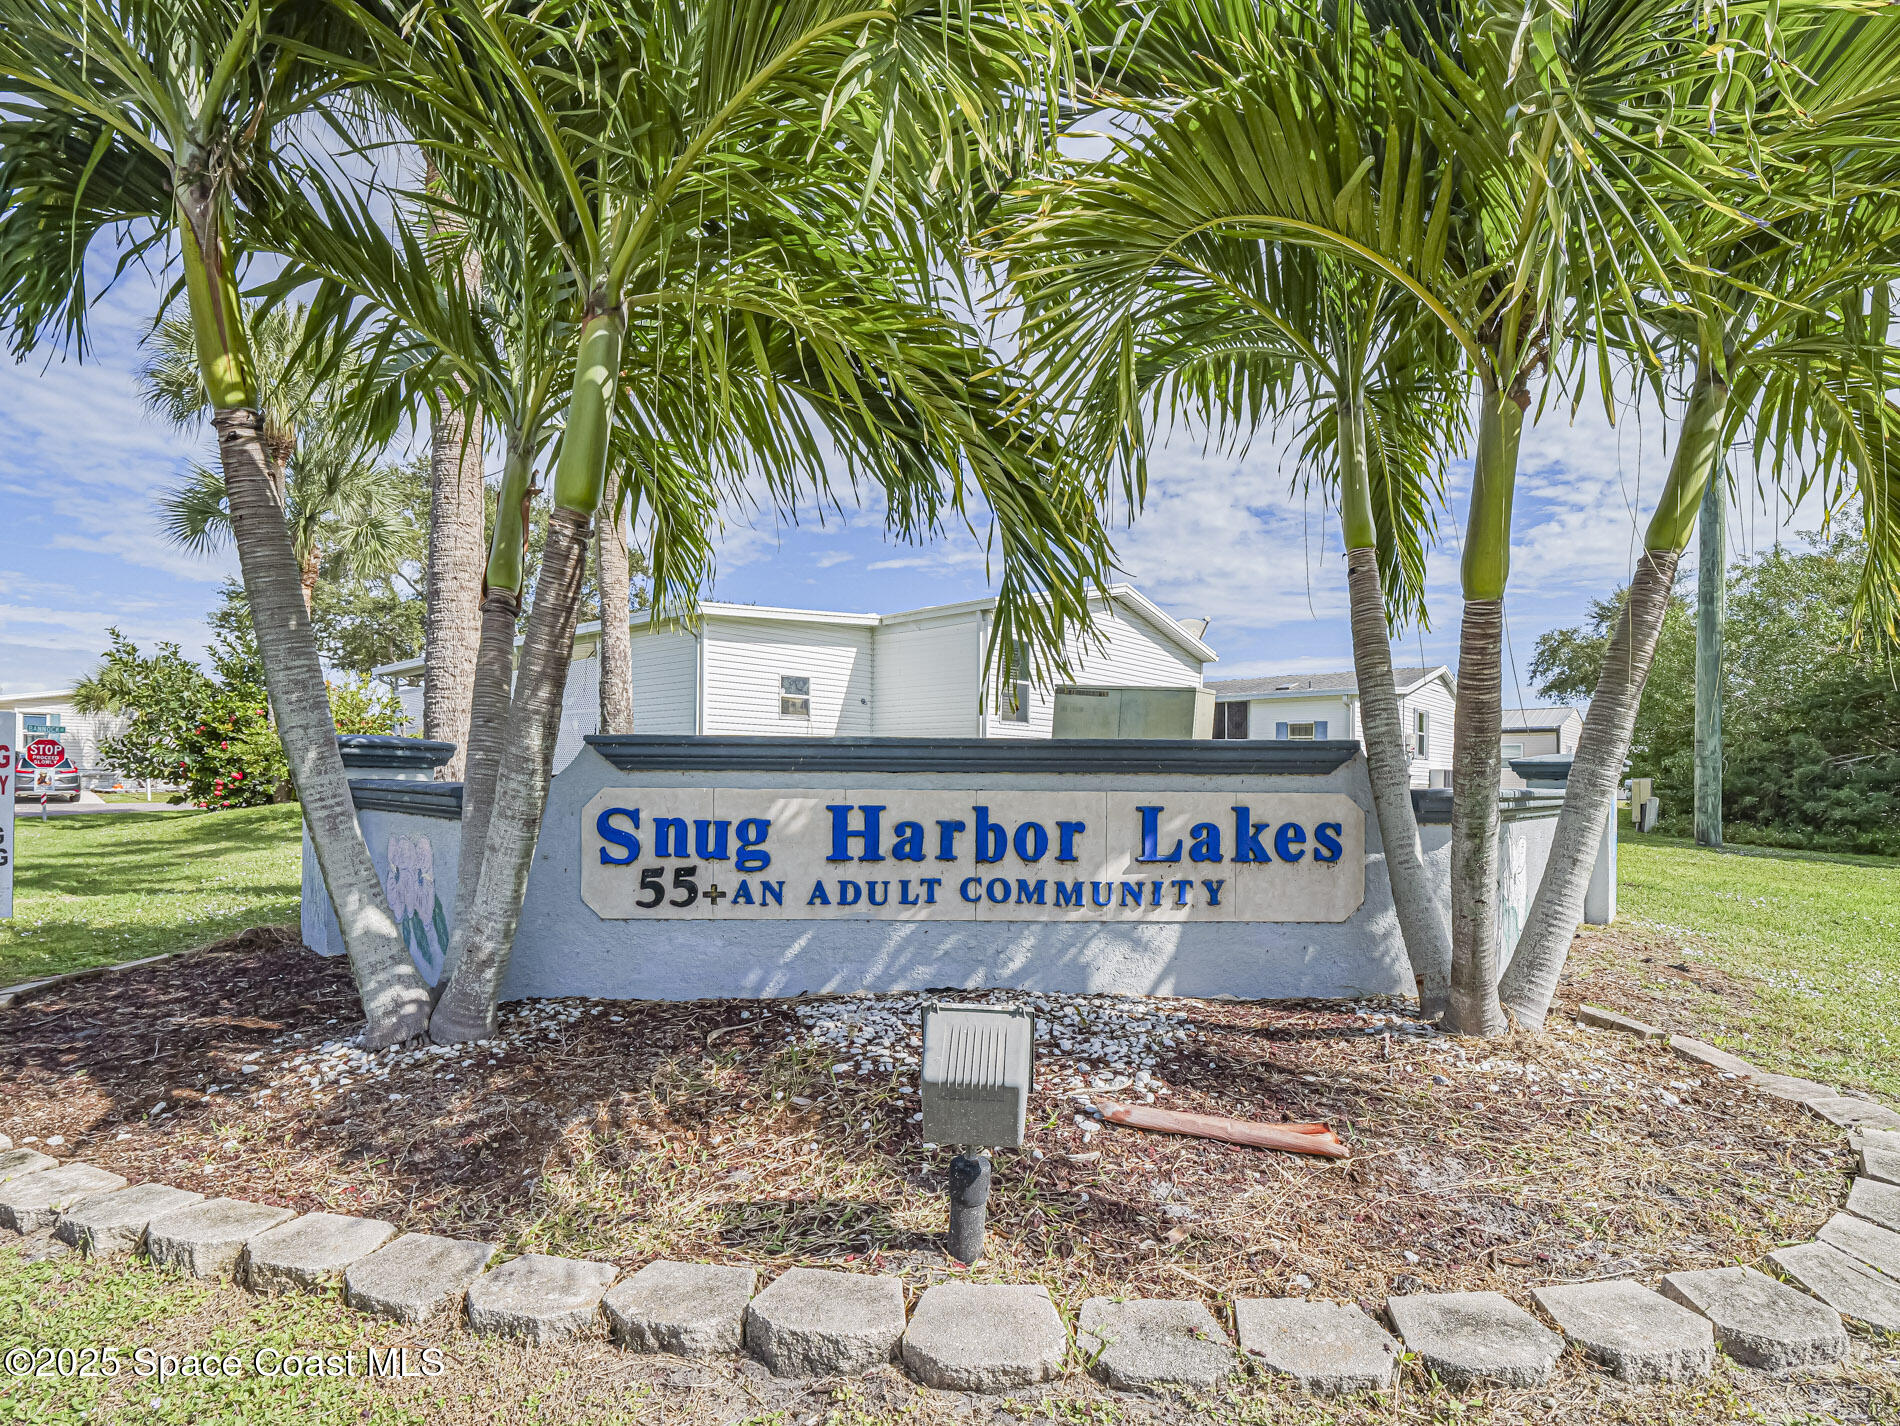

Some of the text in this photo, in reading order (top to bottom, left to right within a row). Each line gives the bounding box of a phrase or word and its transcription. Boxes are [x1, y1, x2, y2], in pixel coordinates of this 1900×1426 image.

[30, 744, 62, 755] STOP
[596, 804, 1344, 872] Snug Harbor Lakes
[635, 864, 1226, 908] 55+ AN ADULT COMMUNITY
